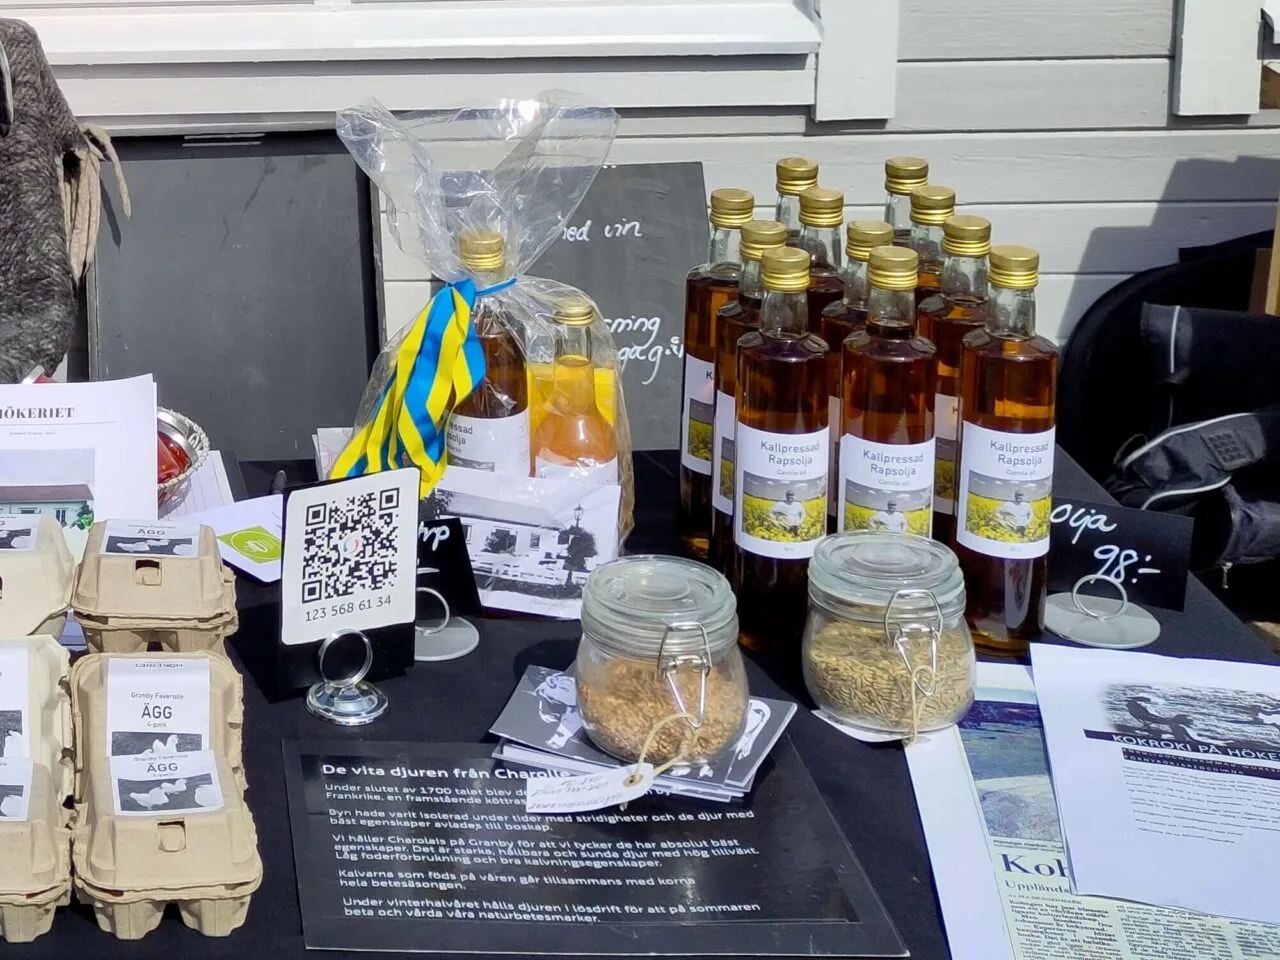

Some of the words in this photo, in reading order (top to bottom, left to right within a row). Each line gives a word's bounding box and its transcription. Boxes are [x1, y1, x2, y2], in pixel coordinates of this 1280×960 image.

[761, 440, 820, 454] Kallpressad
[990, 440, 1049, 454] Kallpressad
[768, 454, 812, 468] Rapsolja
[863, 449, 923, 464] Kallpressad
[998, 454, 1042, 467] Rapsolja
[871, 464, 916, 478] Rapsolja
[304, 607, 327, 622] 123
[331, 602, 354, 617] 568
[358, 598, 372, 611] 61
[376, 594, 392, 608] 34
[131, 691, 154, 700] Granby
[141, 702, 172, 719] ÄGG
[1112, 734, 1192, 752] KOKROKI
[1198, 744, 1223, 755] PÅ
[147, 762, 178, 773] ÄGG
[322, 764, 347, 775] De
[351, 765, 386, 776] vita
[390, 766, 449, 779] djuren
[452, 767, 491, 779] från
[324, 783, 361, 792] Under
[364, 784, 399, 793] slutet
[402, 786, 416, 794] av
[420, 787, 452, 795] 1700
[455, 787, 483, 797] talet
[485, 788, 512, 797] blev
[326, 792, 384, 802] Frankrike,
[387, 795, 402, 803] en
[405, 793, 483, 805] framstående
[328, 808, 352, 818] Byn
[355, 809, 385, 818] hade
[388, 810, 417, 819] varit
[420, 811, 469, 821] isolerad
[472, 812, 510, 822] under
[511, 813, 542, 823] tider
[545, 814, 573, 823] med
[576, 812, 649, 824] stridigheter
[651, 812, 675, 822] och
[678, 812, 694, 821] de
[697, 811, 723, 822] djur
[725, 810, 755, 819] med
[330, 817, 357, 827] bäst
[359, 818, 431, 828] egenskaper
[485, 820, 502, 830] till
[504, 822, 553, 832] boskap.
[332, 834, 345, 842] Vi
[348, 833, 385, 844] håller
[387, 835, 446, 846] Charolais
[450, 836, 465, 847] på
[468, 838, 514, 849] Granby
[517, 839, 536, 848] för
[539, 839, 556, 848] att
[559, 840, 570, 848] vi
[573, 840, 613, 850] tycker
[616, 840, 632, 849] de
[635, 839, 656, 848] har
[660, 838, 709, 848] absolut
[711, 838, 740, 847] bäst
[334, 843, 409, 854] egenskaper.
[412, 845, 436, 853] Det
[438, 846, 452, 854] är
[498, 846, 550, 857] hållbara
[553, 848, 577, 857] och
[580, 849, 619, 858] sunda
[622, 849, 648, 859] djur
[651, 848, 681, 857] med
[683, 848, 710, 859] hög
[712, 847, 760, 857] tillväxt.
[335, 851, 358, 861] Låg
[361, 852, 471, 864] foderförbrukning
[474, 856, 497, 864] och
[500, 856, 522, 865] bra
[524, 856, 663, 868] kalvningsegenskaper.
[338, 869, 394, 878] Kalvarna
[397, 871, 424, 879] som
[427, 871, 456, 881] föds
[460, 872, 476, 882] på
[479, 873, 516, 883] våren
[520, 874, 540, 885] går
[543, 875, 622, 886] tillsammans
[625, 876, 655, 886] med
[658, 876, 696, 886] korna
[340, 878, 368, 888] hela
[343, 897, 384, 907] Under
[386, 897, 480, 909] vinterhalvåret
[482, 900, 516, 910] hålls
[517, 902, 562, 913] djuren
[572, 904, 622, 914] lösdrift
[624, 904, 644, 914] för
[647, 905, 667, 914] att
[669, 904, 686, 915] på
[688, 903, 761, 913] sommaren
[344, 907, 374, 916] beta
[378, 908, 403, 917] och
[406, 908, 443, 918] vårda
[445, 909, 476, 919] våra
[478, 911, 601, 923] naturbetesmarker.
